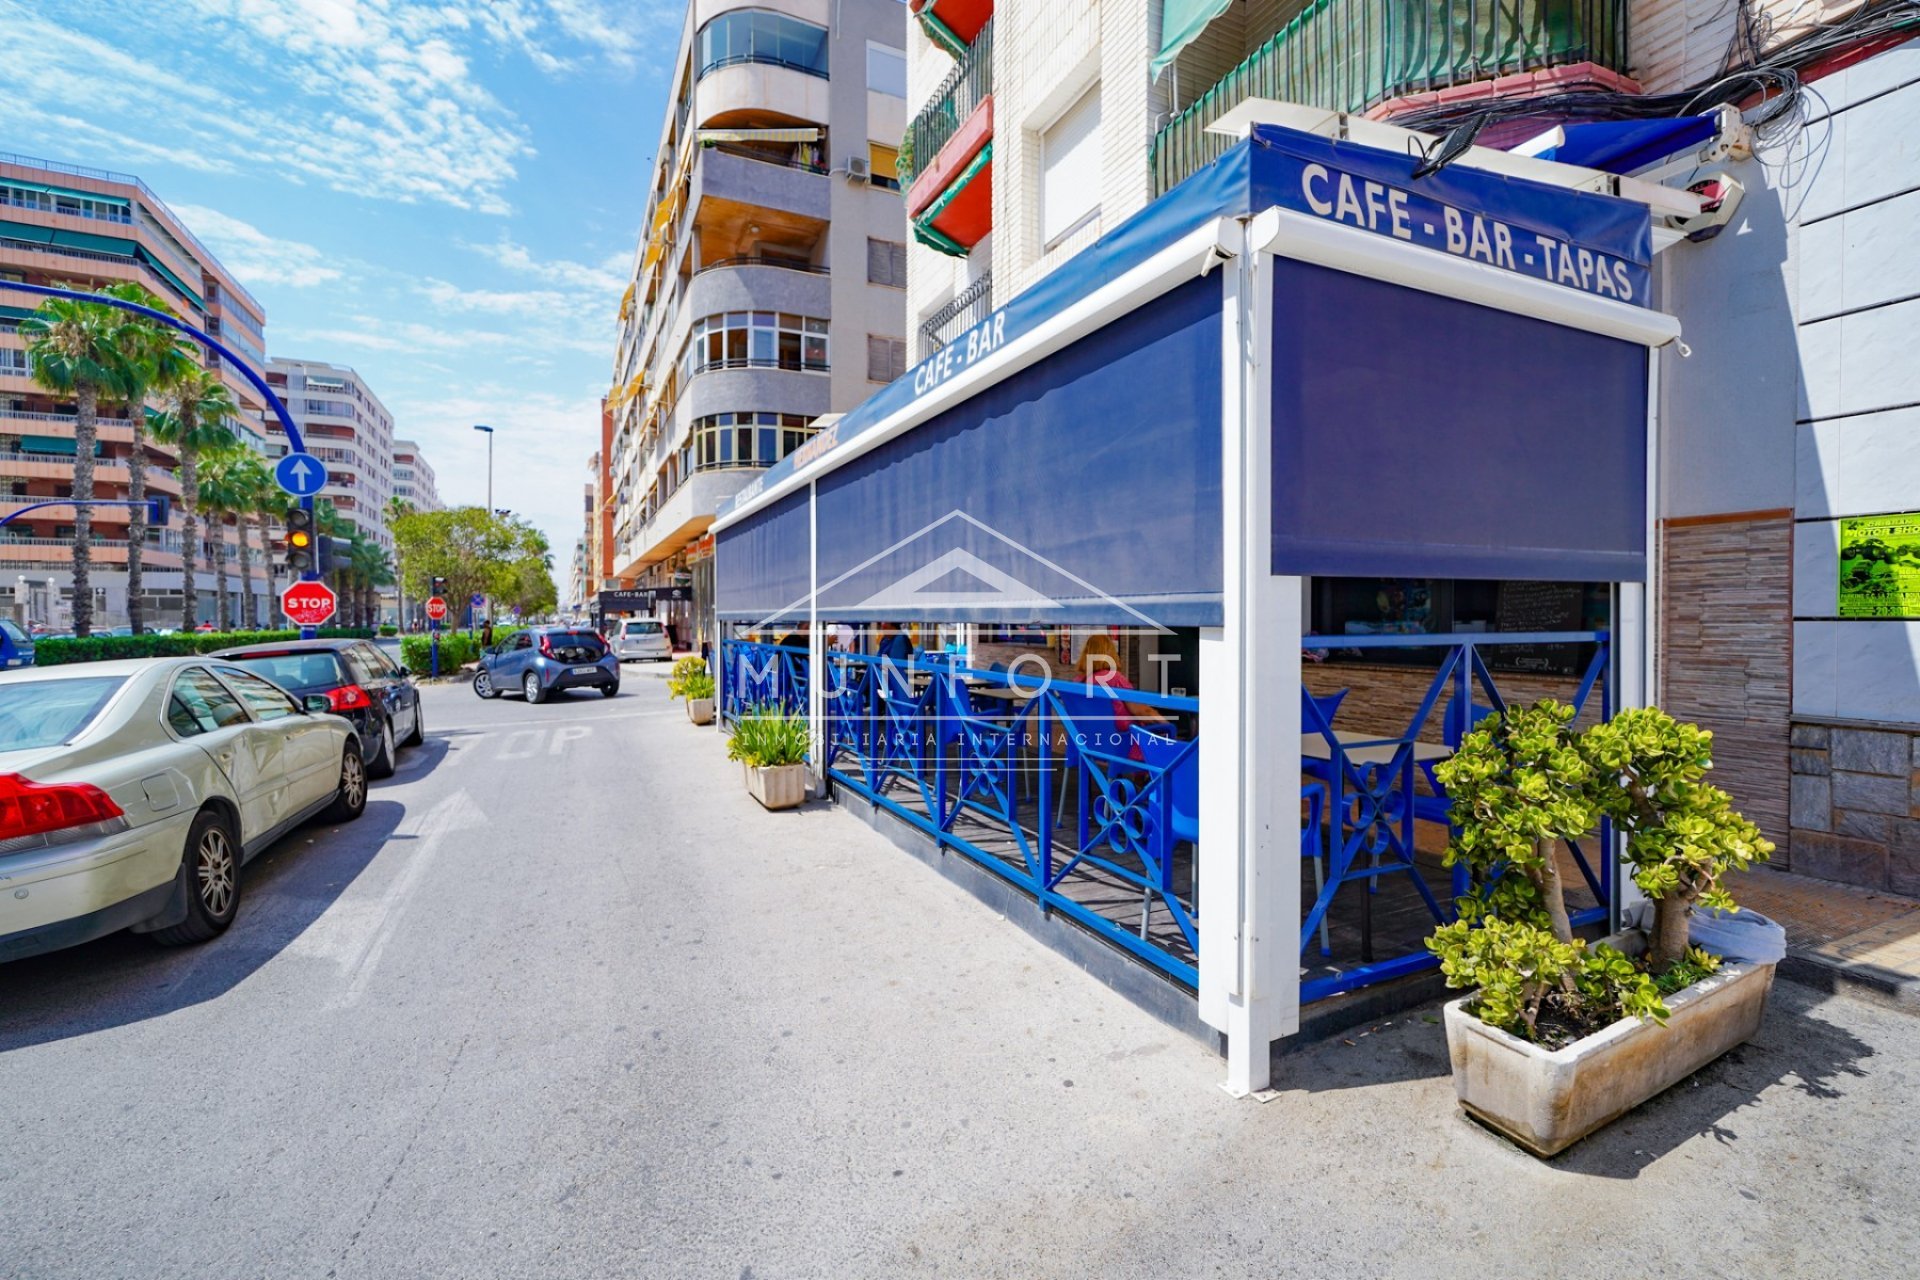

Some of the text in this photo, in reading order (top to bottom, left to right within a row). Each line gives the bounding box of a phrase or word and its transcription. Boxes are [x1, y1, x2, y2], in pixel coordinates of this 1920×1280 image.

[1302, 163, 1412, 240] CAFE
[1443, 205, 1516, 270] BAR
[1536, 234, 1633, 301] TAPAS
[914, 344, 955, 396] CAFE
[966, 310, 1006, 365] BAR
[287, 597, 332, 609] STOP
[427, 603, 446, 613] STOP
